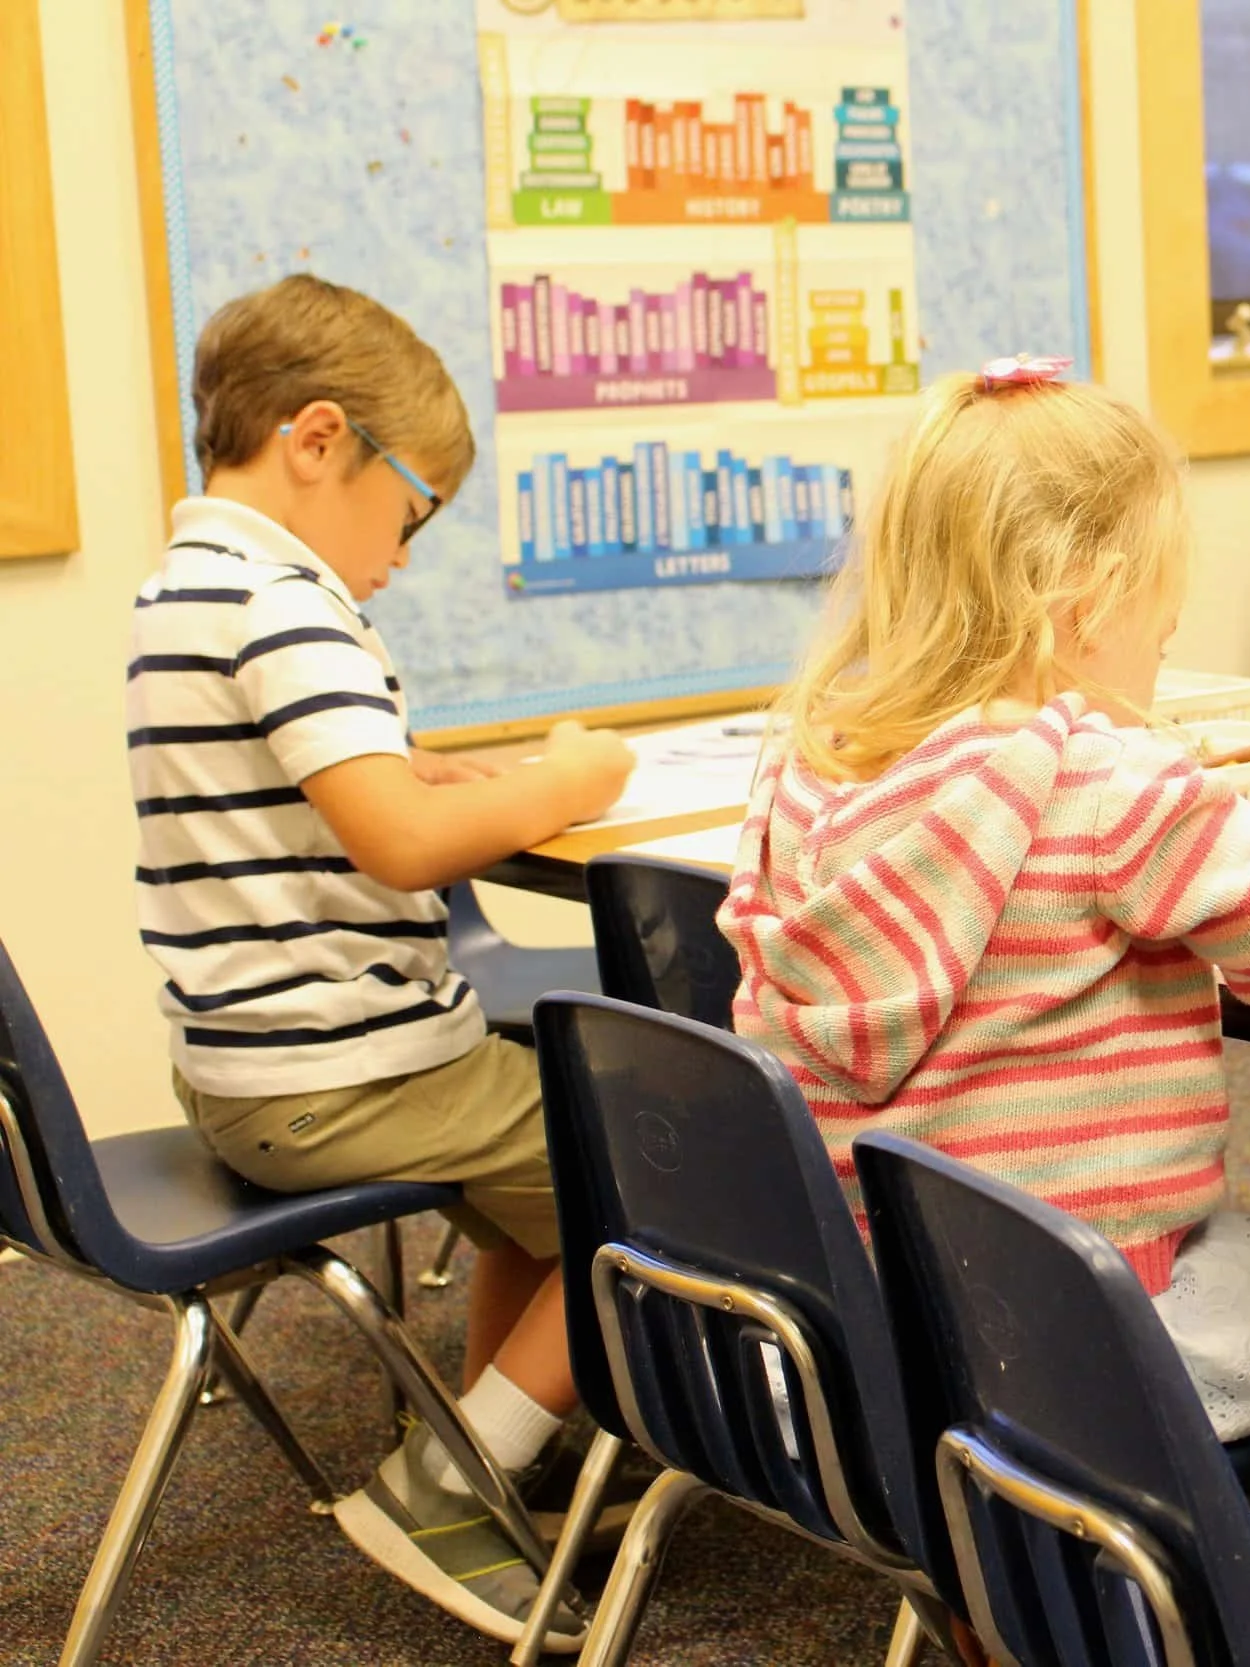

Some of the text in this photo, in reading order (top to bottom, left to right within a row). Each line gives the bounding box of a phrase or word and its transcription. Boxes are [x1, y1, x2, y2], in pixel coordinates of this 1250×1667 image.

[540, 195, 583, 218] LAW
[685, 198, 760, 217] HISTORY
[837, 197, 901, 216] POETRY
[595, 380, 688, 403] PROPHETS
[804, 372, 877, 392] GOSPELS
[655, 553, 731, 578] LETTERS
